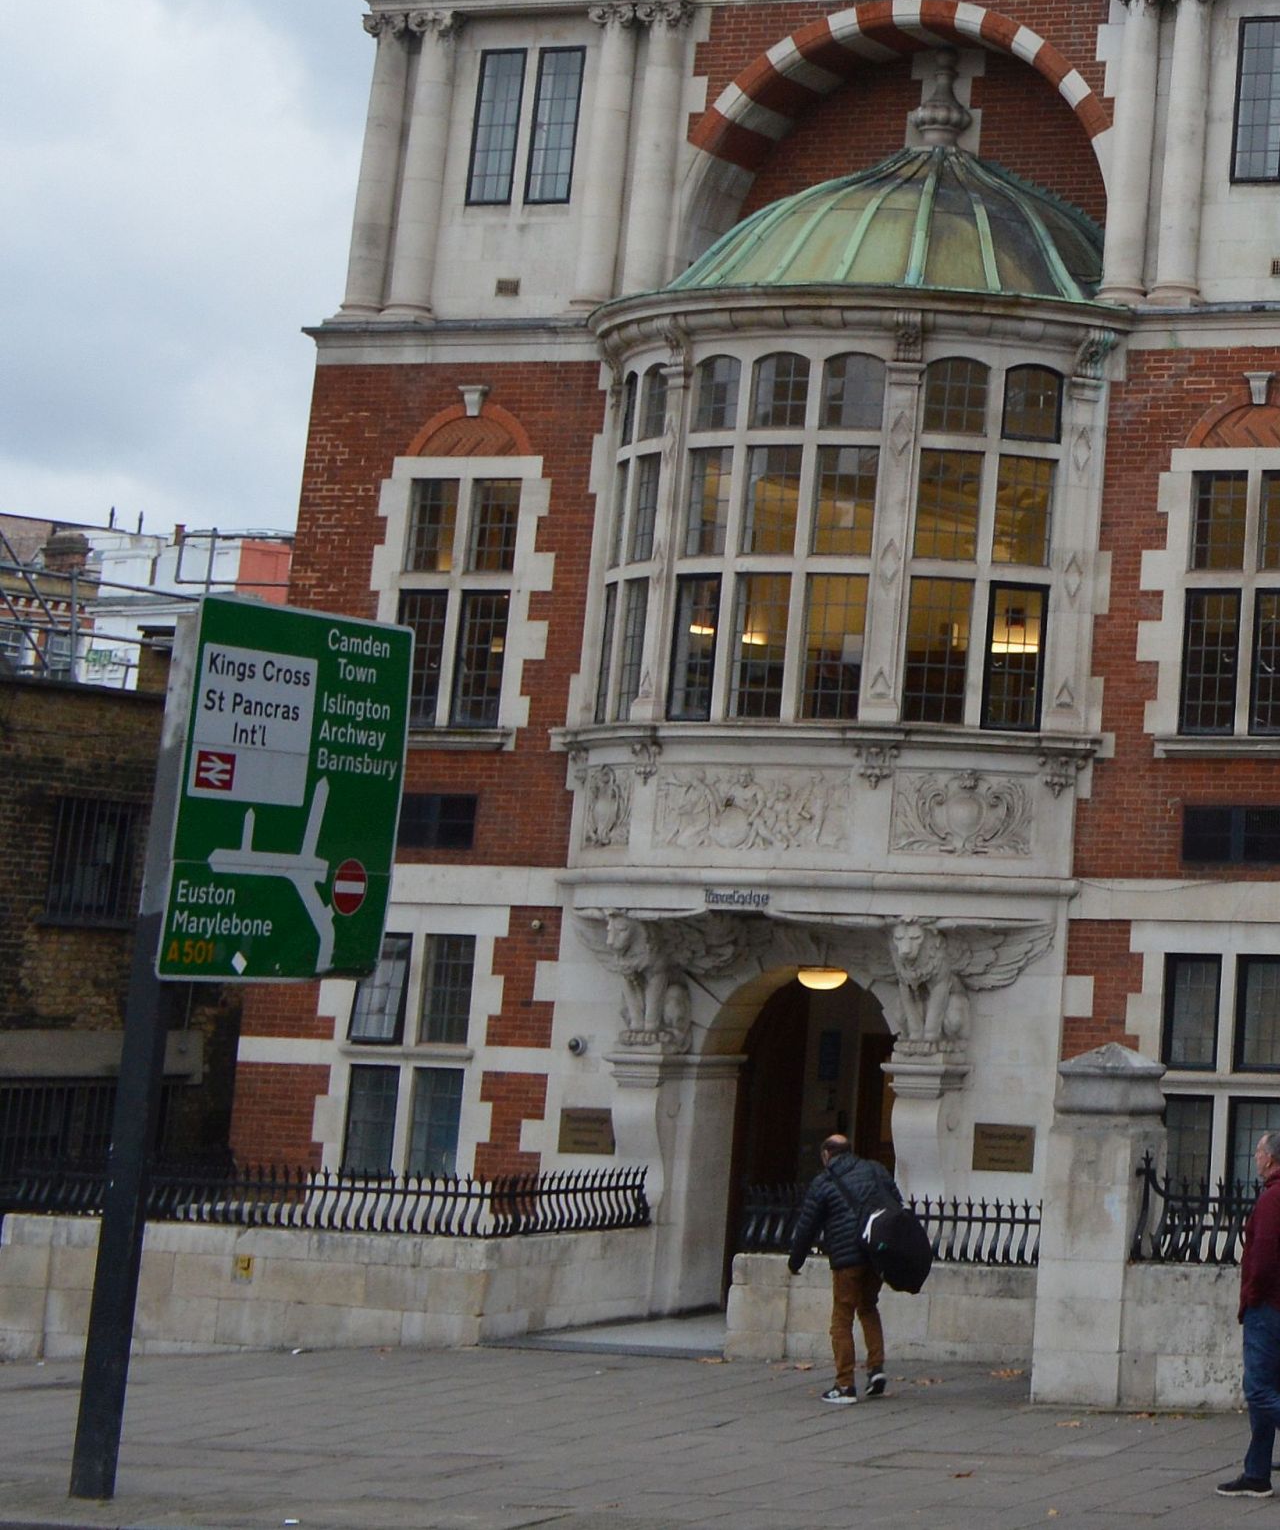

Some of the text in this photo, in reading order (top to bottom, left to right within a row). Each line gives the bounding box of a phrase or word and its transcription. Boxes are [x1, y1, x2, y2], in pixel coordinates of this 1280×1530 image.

[328, 628, 391, 658] Camden
[208, 651, 311, 687] Kings Cross
[337, 658, 377, 683] Town
[204, 689, 300, 722] St Pancras
[322, 691, 391, 721] Islington
[319, 719, 386, 752] Archway
[316, 747, 398, 781] Barnsbury
[176, 880, 236, 905] Euston
[172, 910, 273, 939] Marylebone
